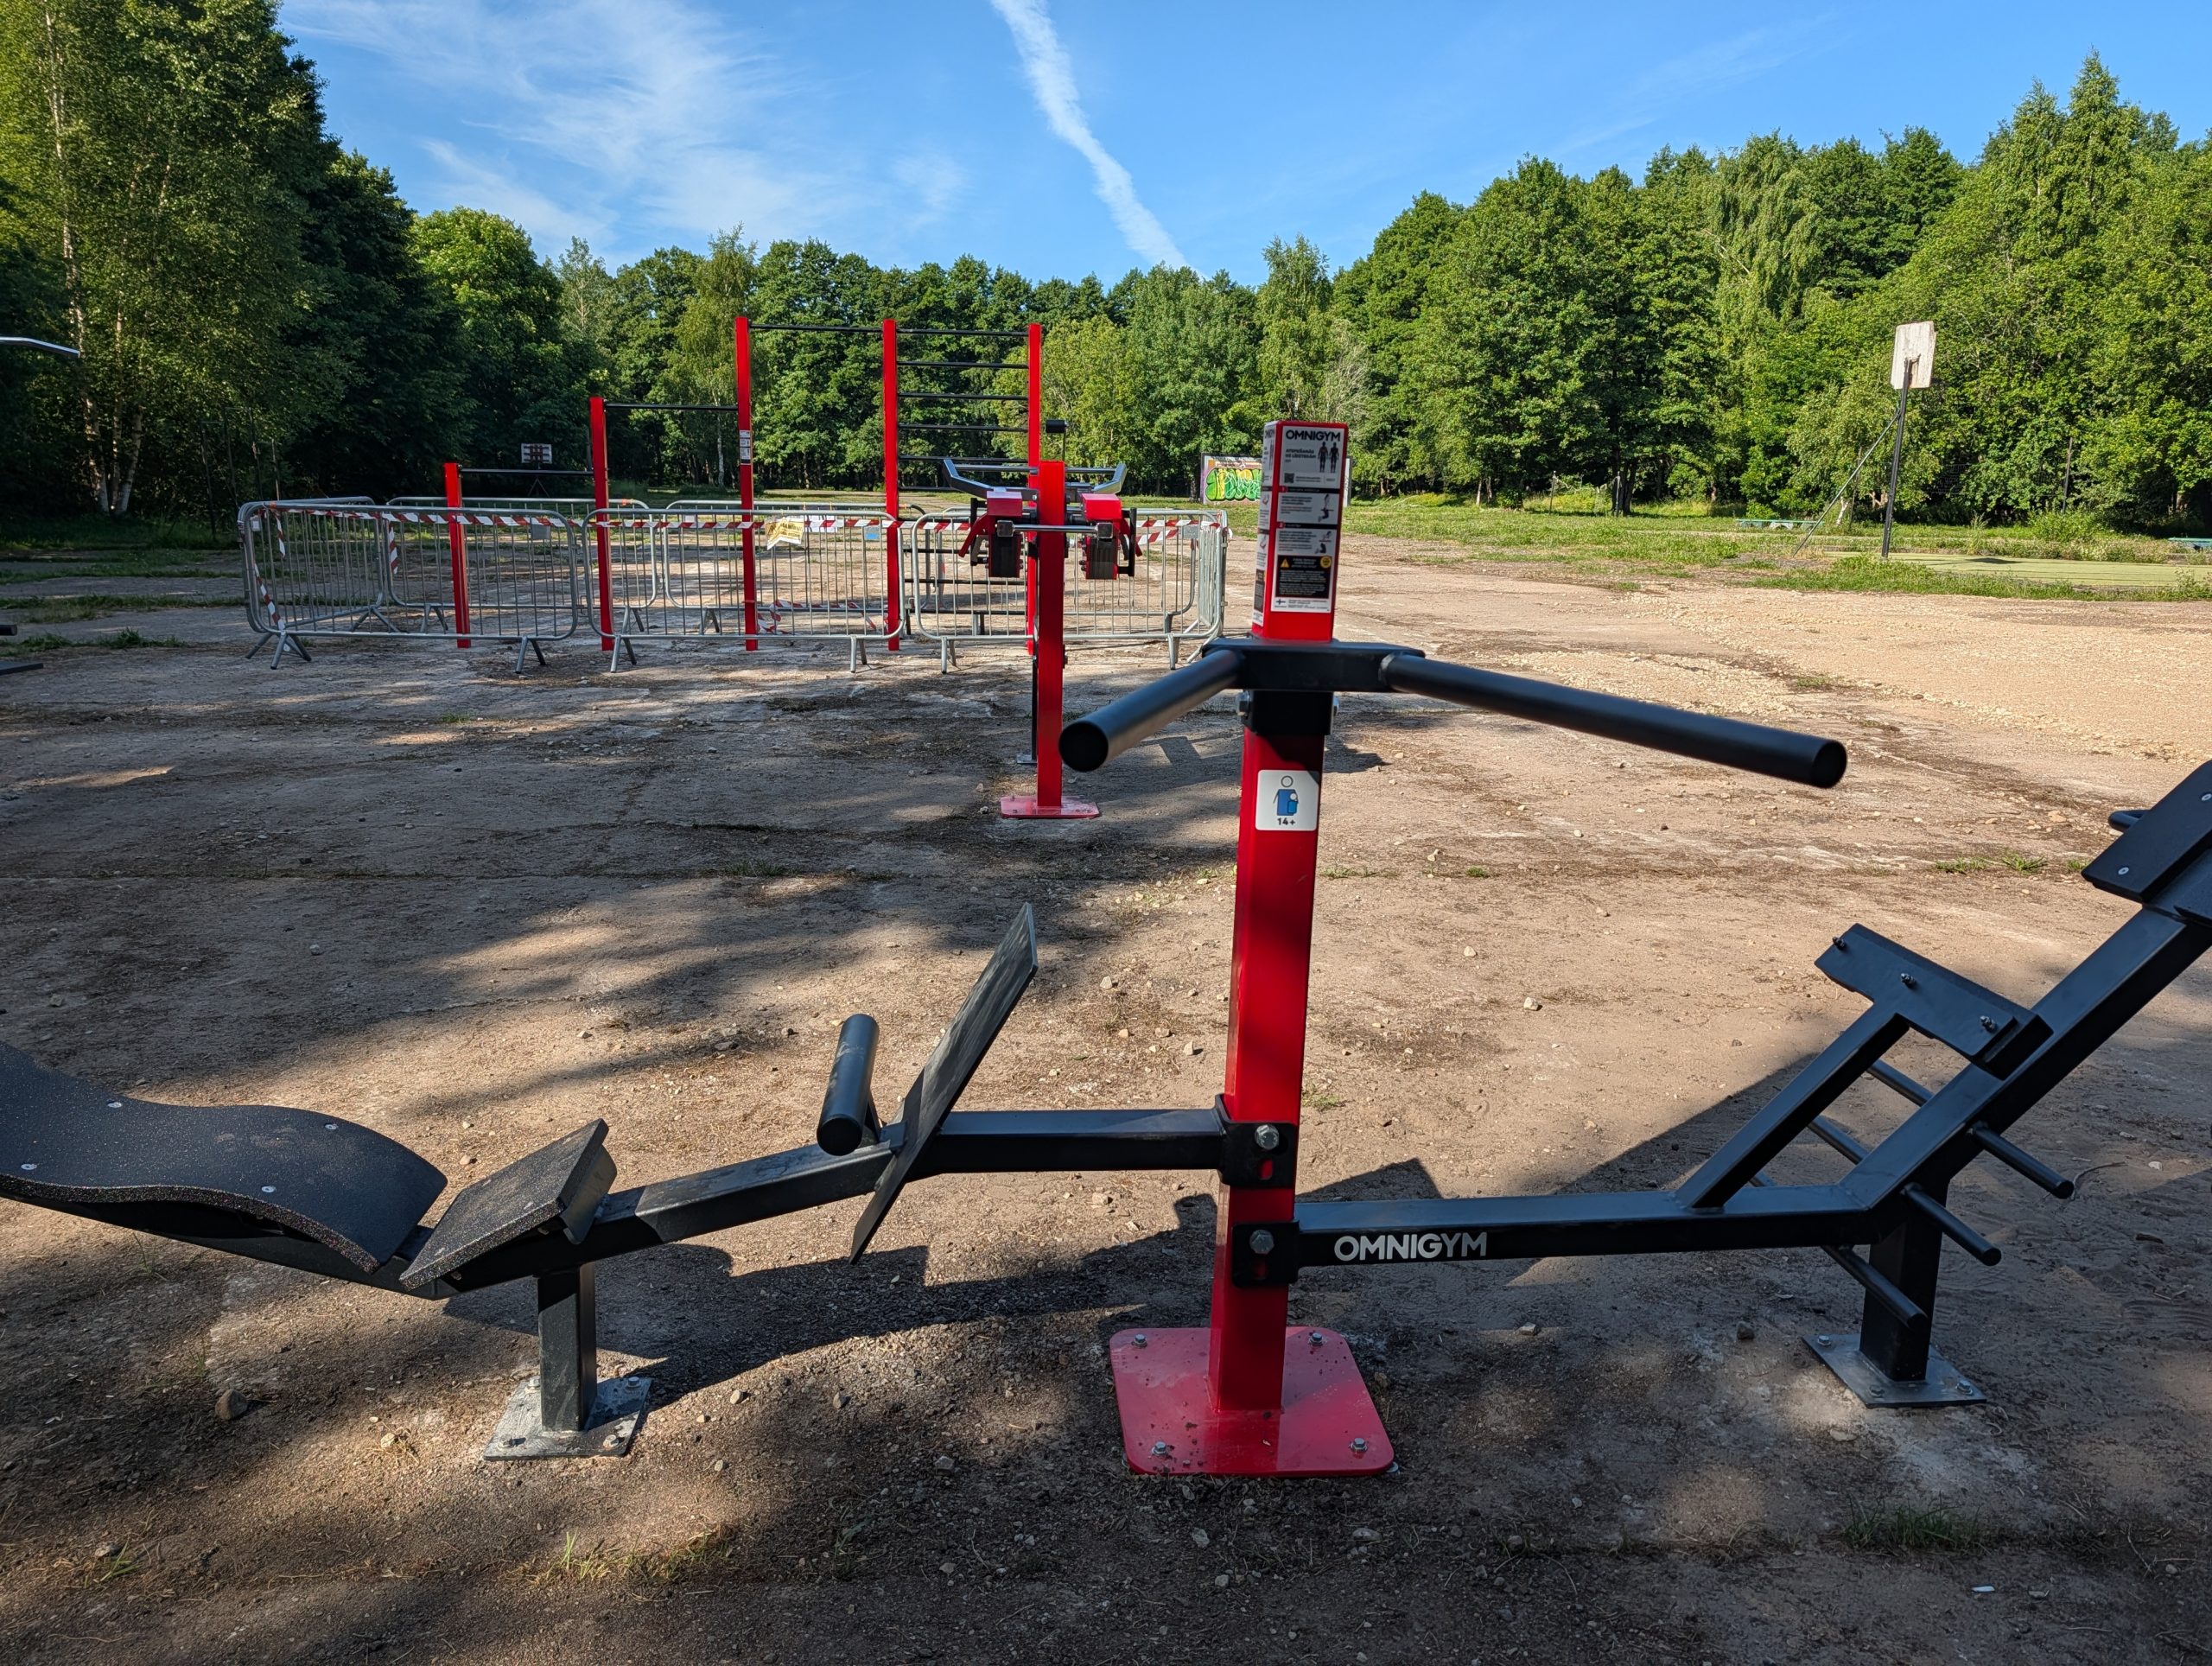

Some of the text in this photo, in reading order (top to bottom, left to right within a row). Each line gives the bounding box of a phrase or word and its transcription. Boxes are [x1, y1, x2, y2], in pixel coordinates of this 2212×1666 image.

[1286, 429, 1341, 442] OMNIGYM
[1277, 817, 1296, 826] 14+
[1333, 1232, 1488, 1262] OMNIGYM
